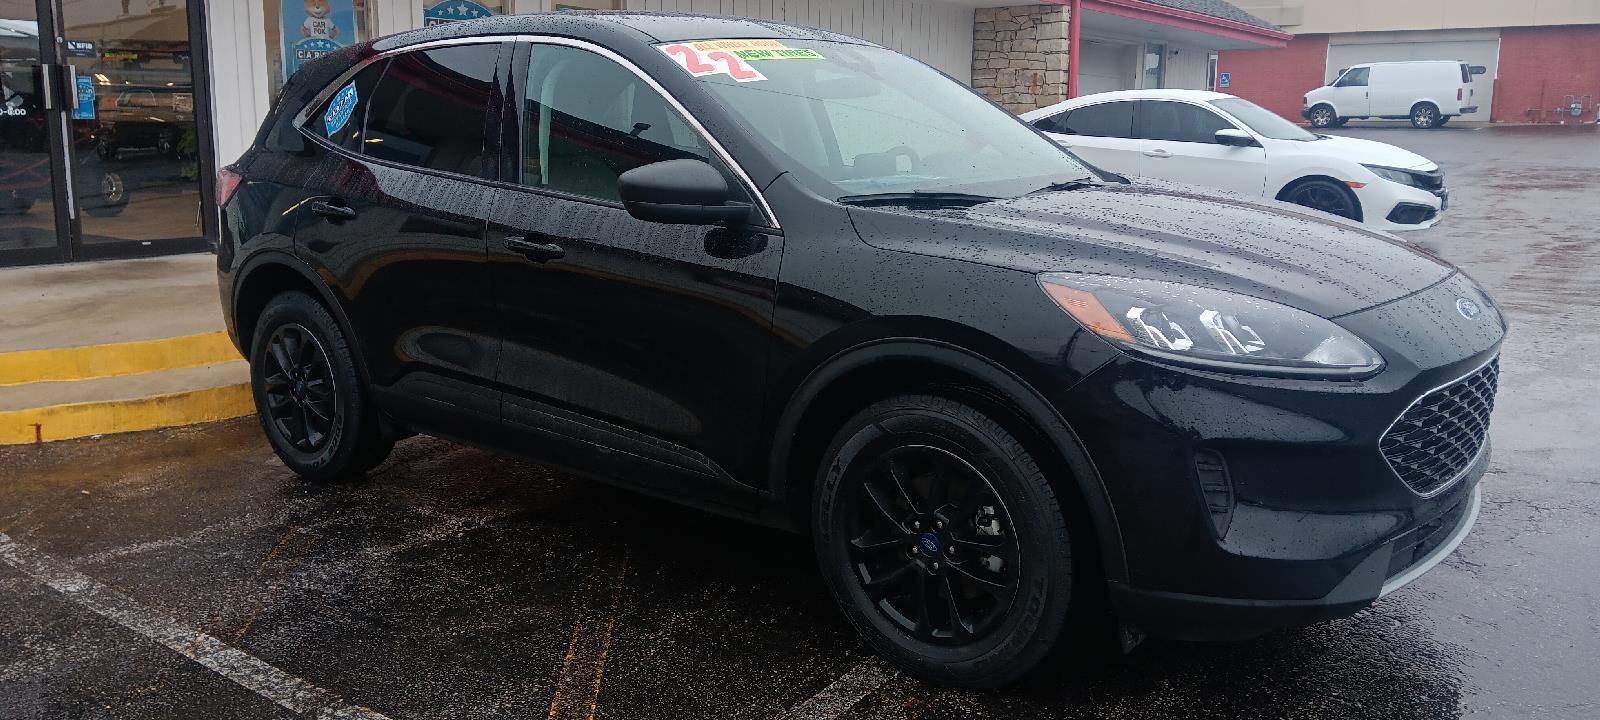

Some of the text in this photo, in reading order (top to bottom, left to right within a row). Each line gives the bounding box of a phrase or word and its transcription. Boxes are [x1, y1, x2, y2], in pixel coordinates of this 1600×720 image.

[665, 44, 758, 80] 22
[733, 49, 819, 59] NEW TIRES
